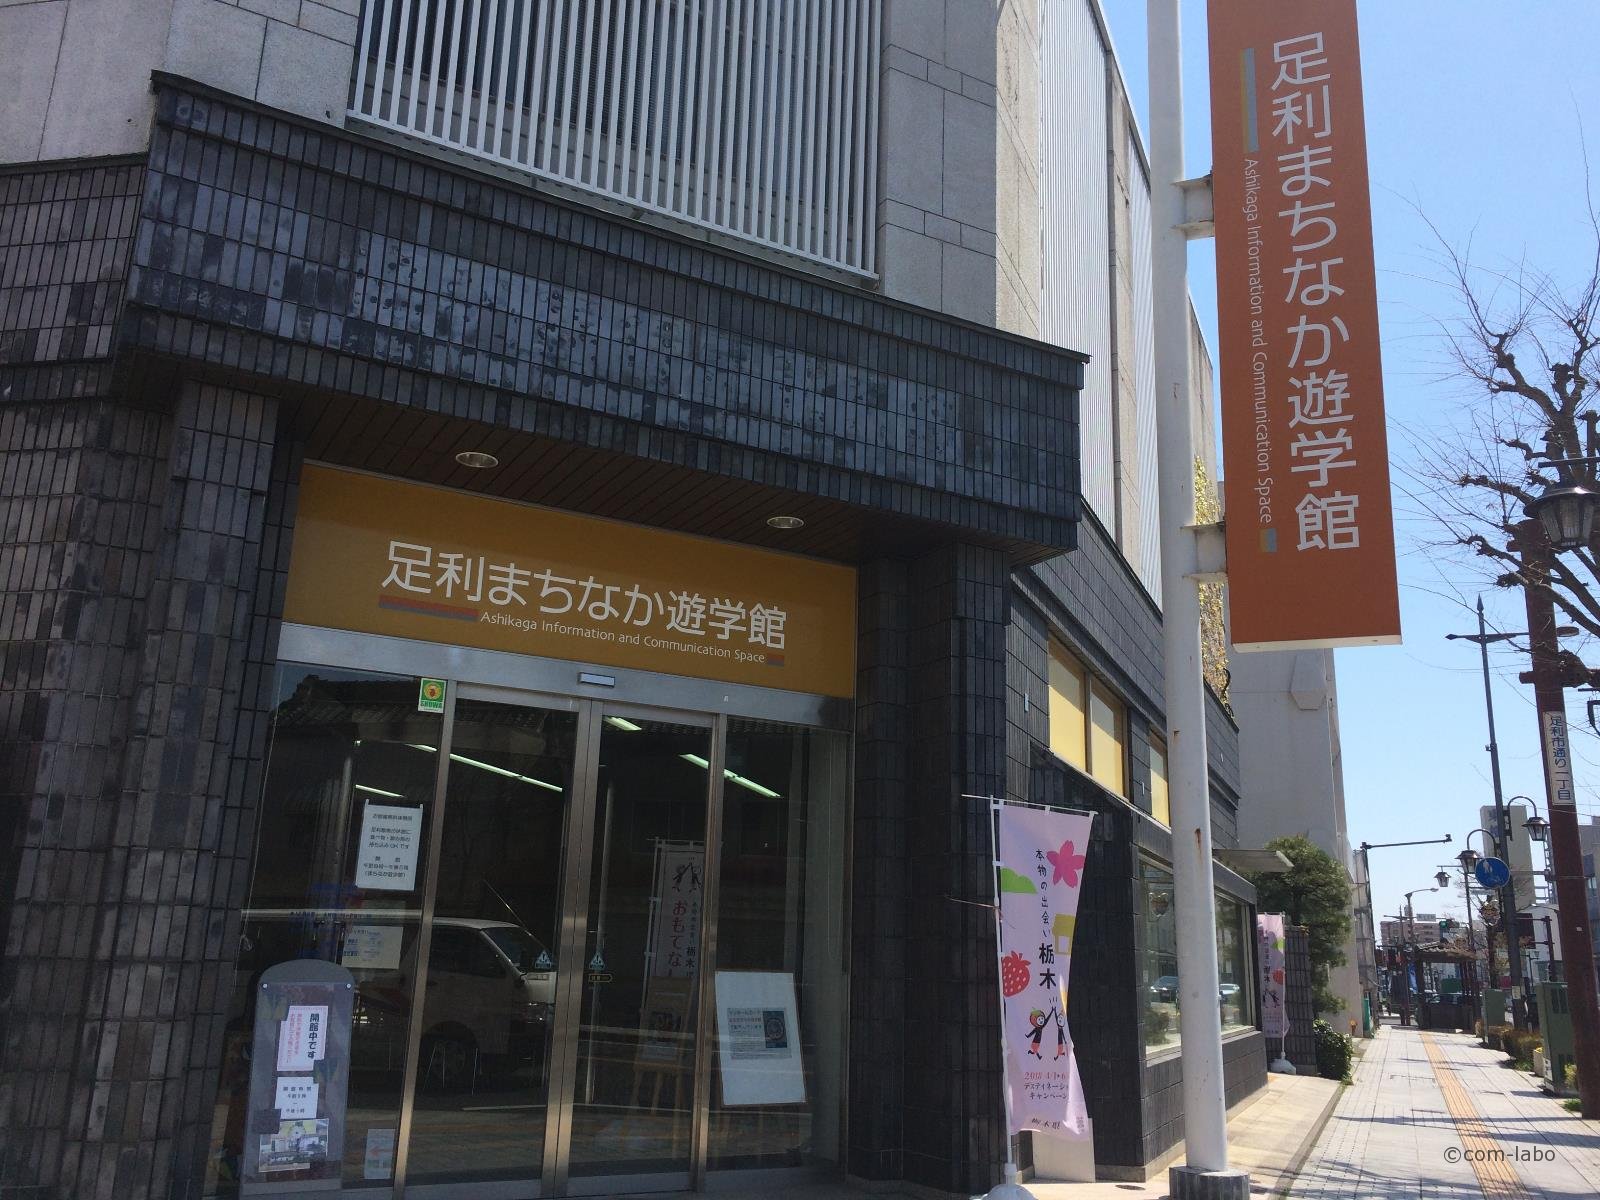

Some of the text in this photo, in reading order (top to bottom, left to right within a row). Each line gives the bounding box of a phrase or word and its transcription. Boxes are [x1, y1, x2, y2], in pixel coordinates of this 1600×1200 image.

[1243, 158, 1274, 524] Ashikaga Information and Communication Space
[1270, 31, 1361, 552] 足利まちなか遊学館
[380, 539, 788, 650] 足利まちなか遊学館
[480, 611, 766, 664] Ashikaga Information and Communication Space
[1550, 715, 1571, 800] 足利市通り一丁目
[1035, 848, 1057, 989] 本物の出会い 栃木
[307, 1013, 320, 1060] 開館中です
